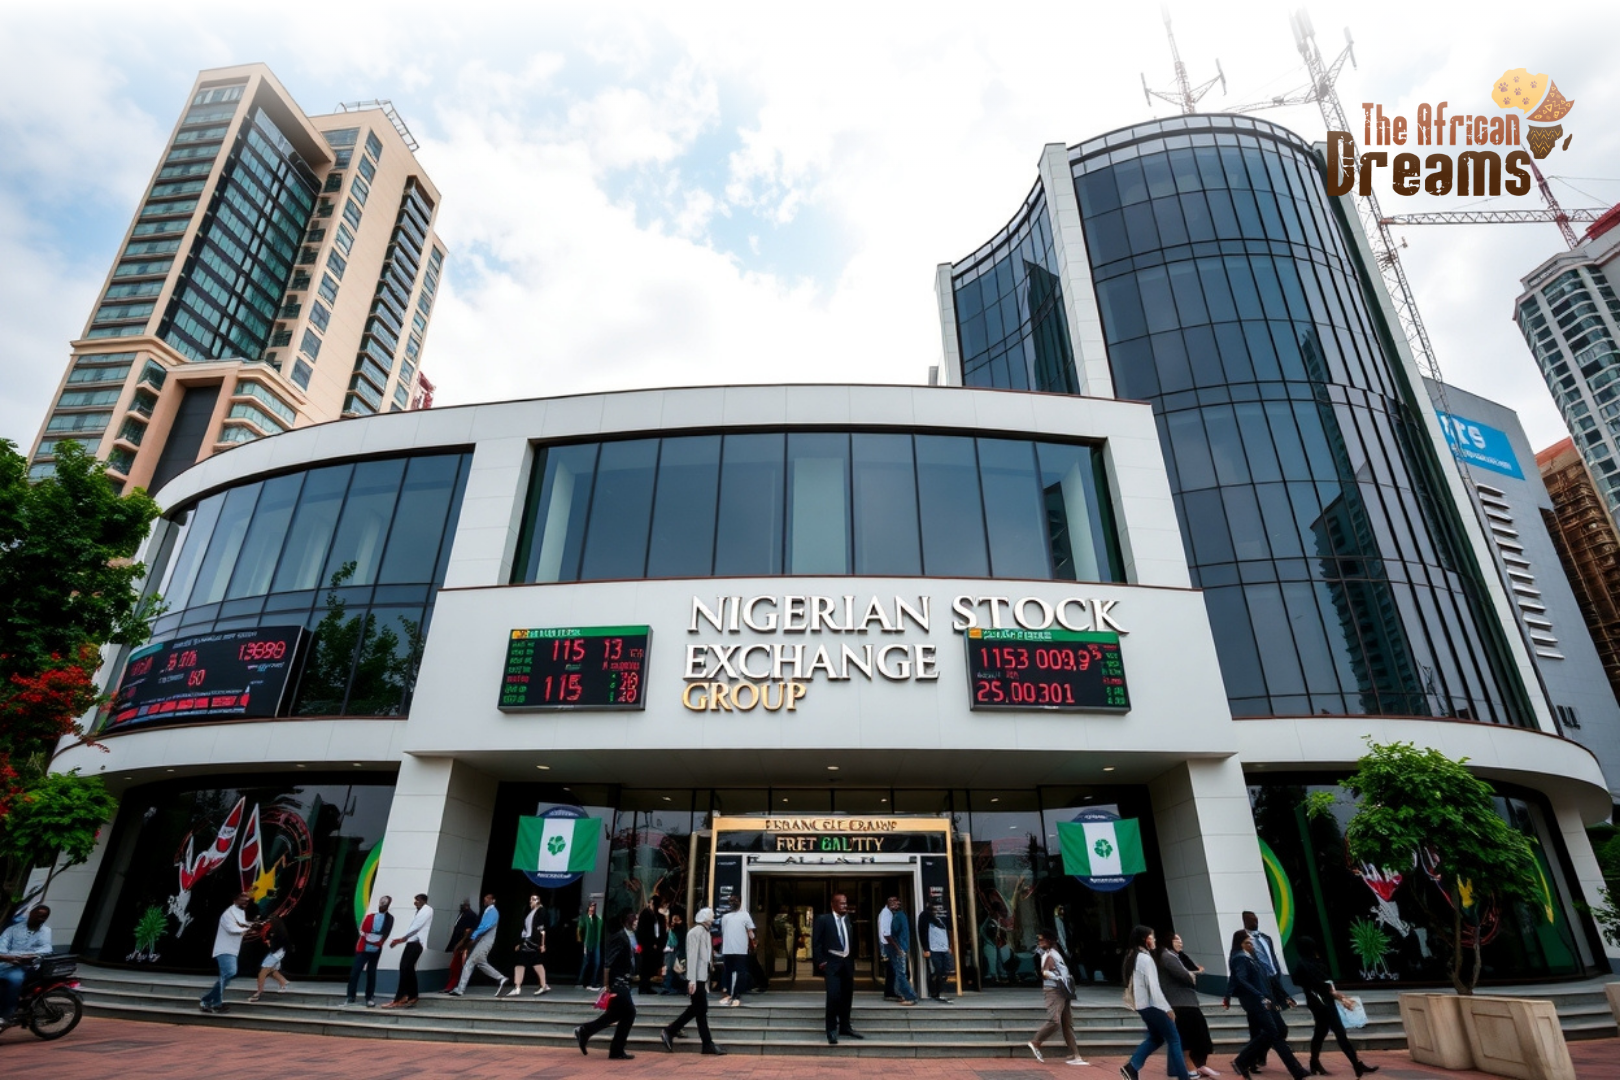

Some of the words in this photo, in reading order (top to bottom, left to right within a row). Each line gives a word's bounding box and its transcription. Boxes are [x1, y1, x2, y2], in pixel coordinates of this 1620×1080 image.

[687, 595, 931, 634] NIGERIAN
[952, 595, 1130, 636] STOCK
[682, 643, 940, 682] EXCHANGE
[682, 681, 807, 712] GROUP
